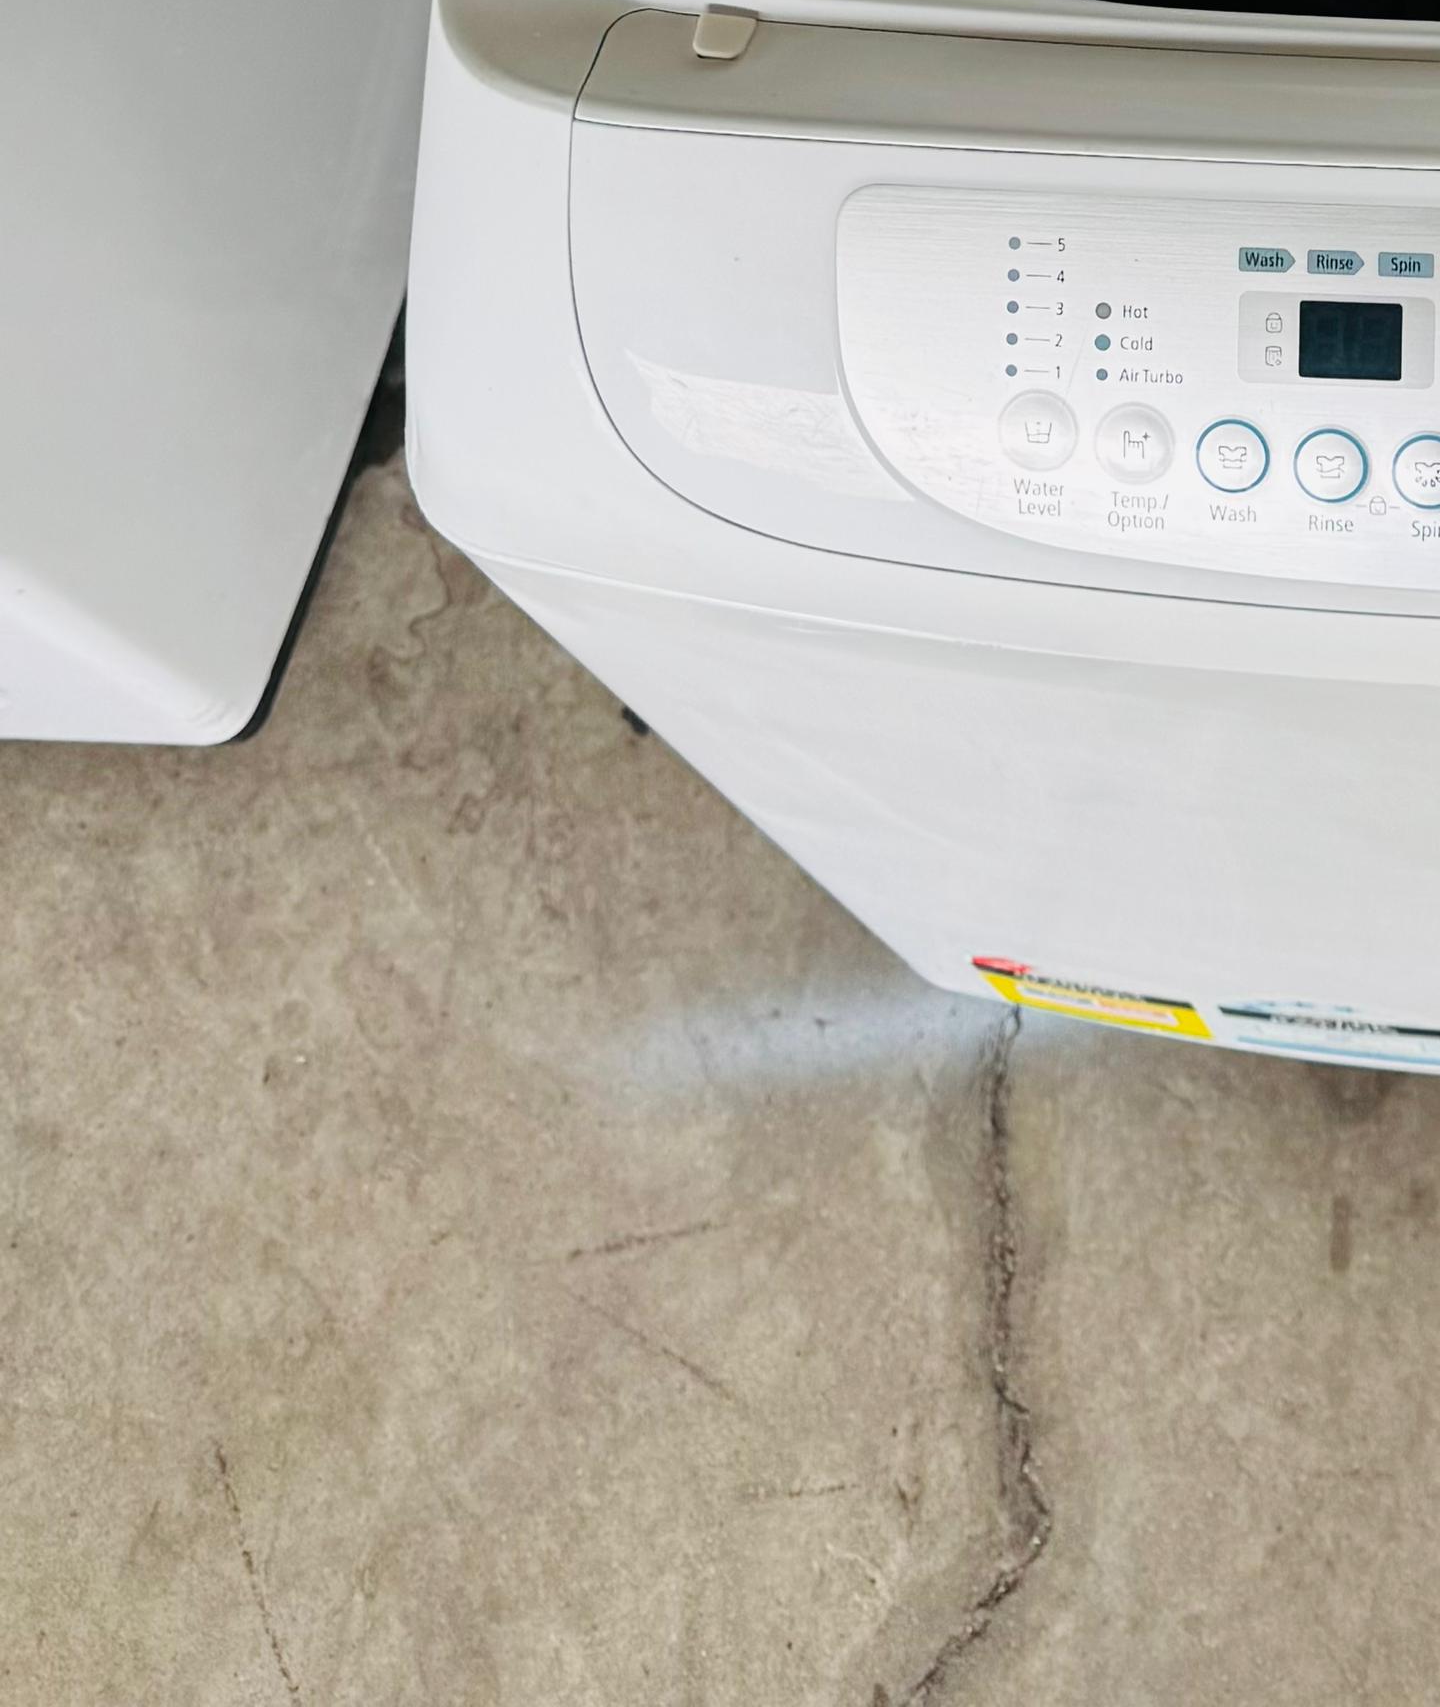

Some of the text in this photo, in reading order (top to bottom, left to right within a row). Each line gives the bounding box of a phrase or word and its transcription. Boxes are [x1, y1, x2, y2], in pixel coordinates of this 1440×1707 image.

[1057, 237, 1067, 253] 5
[1245, 251, 1285, 269] Wash
[1316, 254, 1354, 271] Rinse
[1391, 257, 1421, 274] Spin
[1055, 269, 1066, 284] 4
[1055, 301, 1065, 317] 3
[1121, 303, 1149, 320] Hot
[1054, 333, 1064, 349] 2
[1119, 335, 1154, 352] Cold
[1055, 365, 1062, 380] 1
[1118, 367, 1185, 385] Air Turbo
[1012, 477, 1066, 498] Water
[1017, 498, 1062, 518] Level
[1208, 503, 1258, 524] Wash
[1106, 510, 1166, 533] Option
[1307, 513, 1355, 534] Rinse
